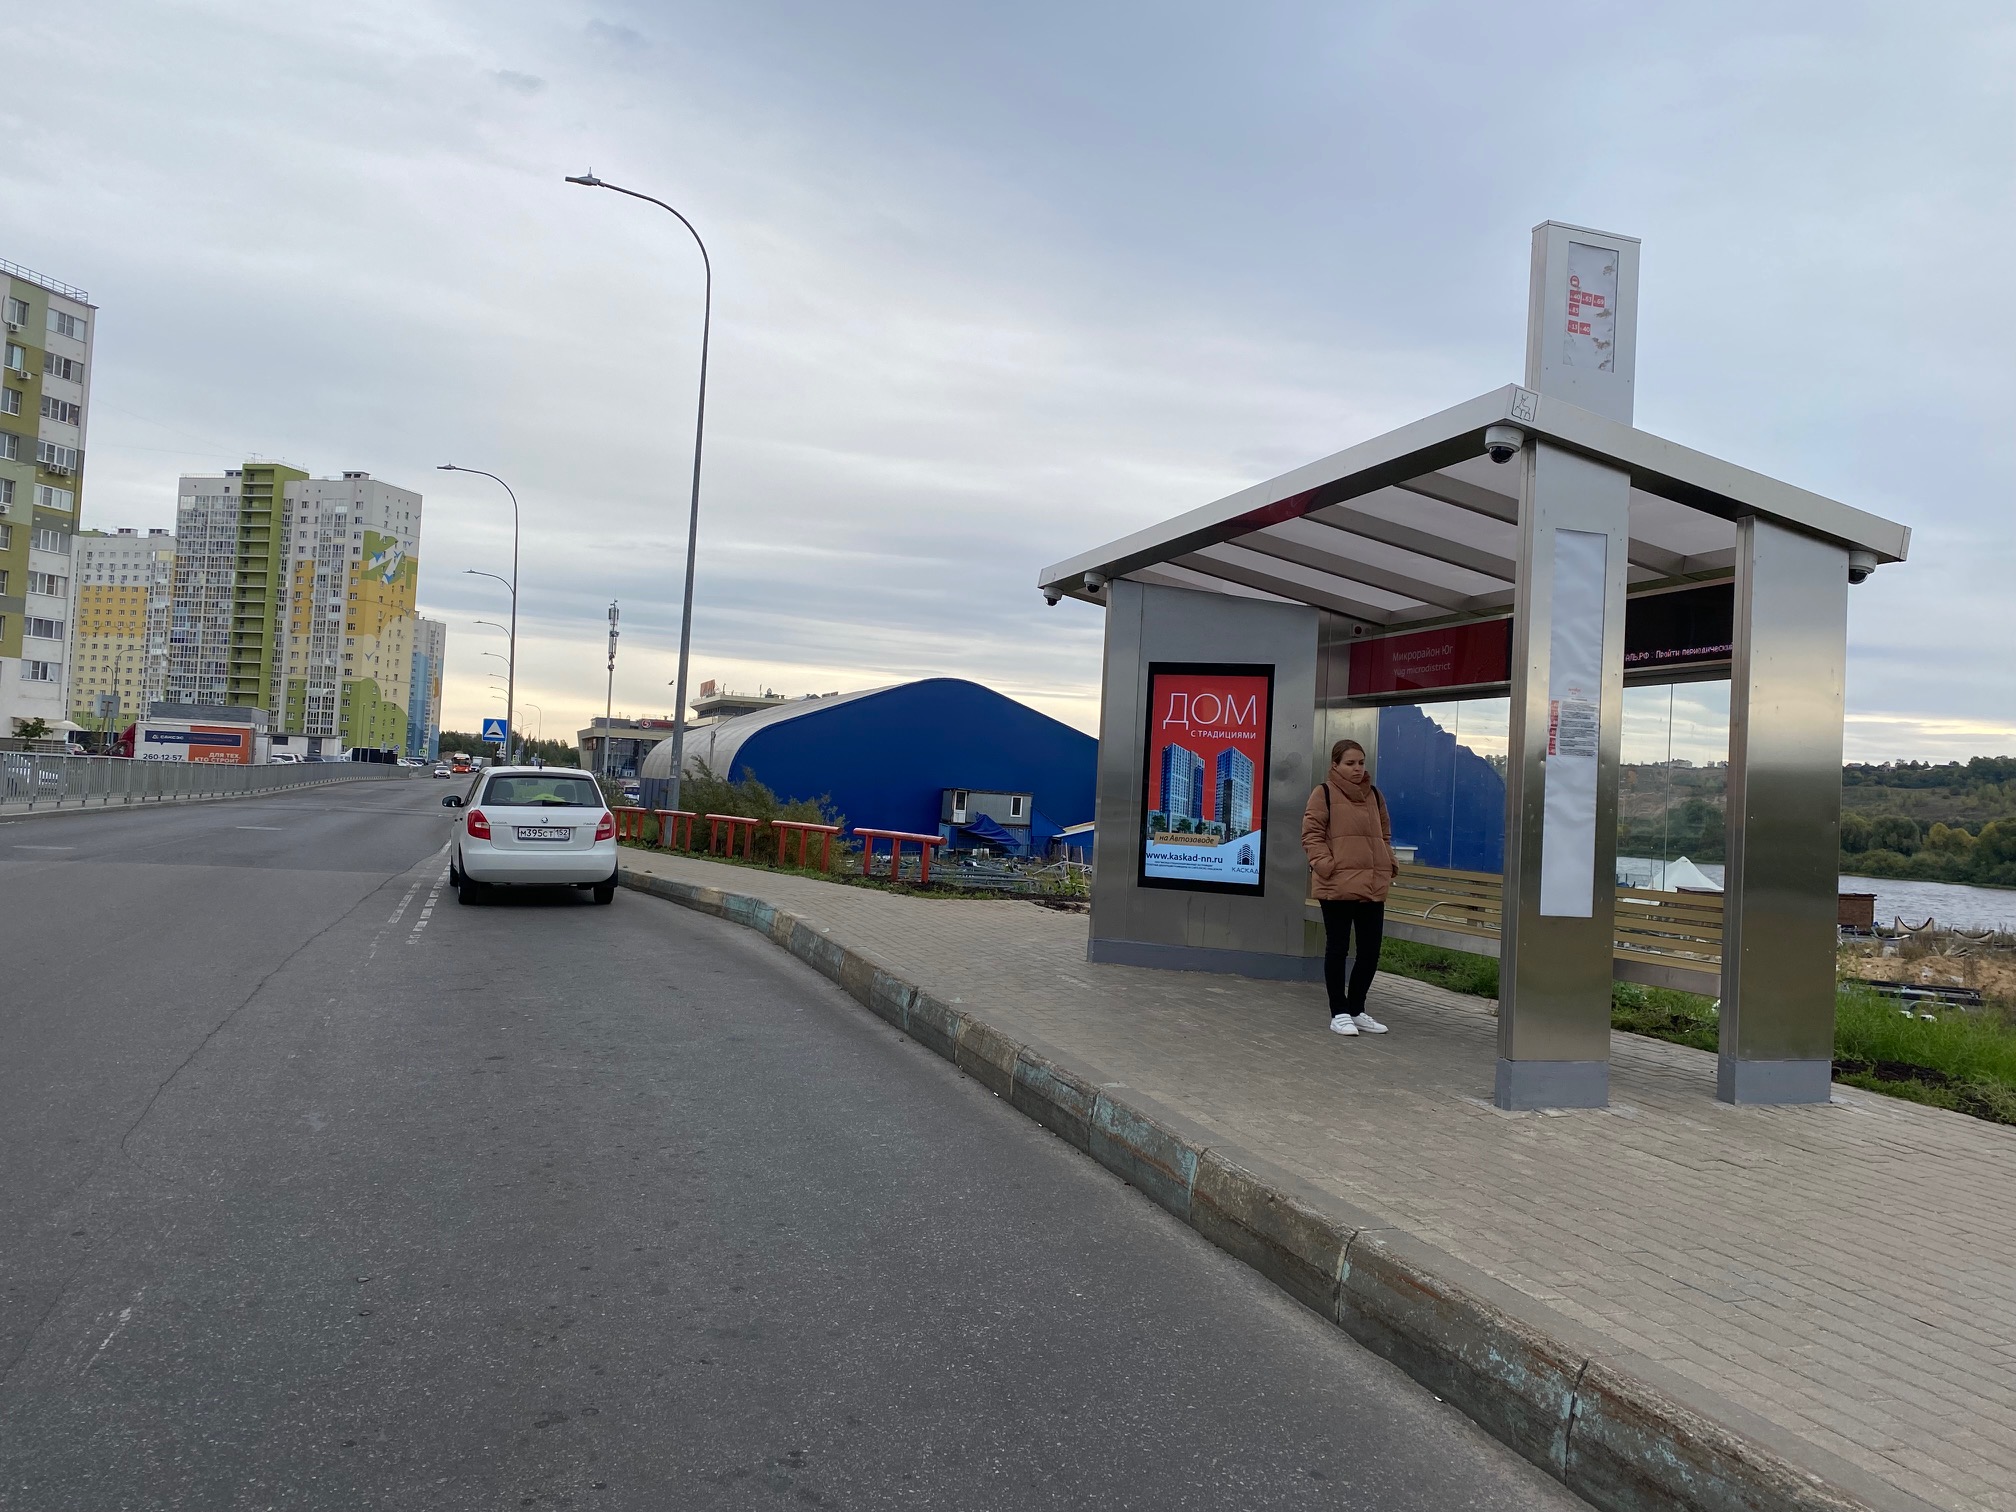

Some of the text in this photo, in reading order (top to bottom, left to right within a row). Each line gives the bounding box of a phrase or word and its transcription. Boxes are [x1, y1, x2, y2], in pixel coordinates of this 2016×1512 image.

[1392, 645, 1454, 662] Микрорайон Юг
[1393, 663, 1450, 677] Yug microdistrict
[1163, 693, 1256, 730] ДОМ
[1190, 730, 1256, 739] С ТРАДИЦИЯМИ
[555, 829, 568, 837] 152
[1170, 834, 1215, 845] Автозаводе
[1146, 852, 1223, 864] www.kaskad-nn.ru
[1232, 867, 1259, 875] КАСКАД
